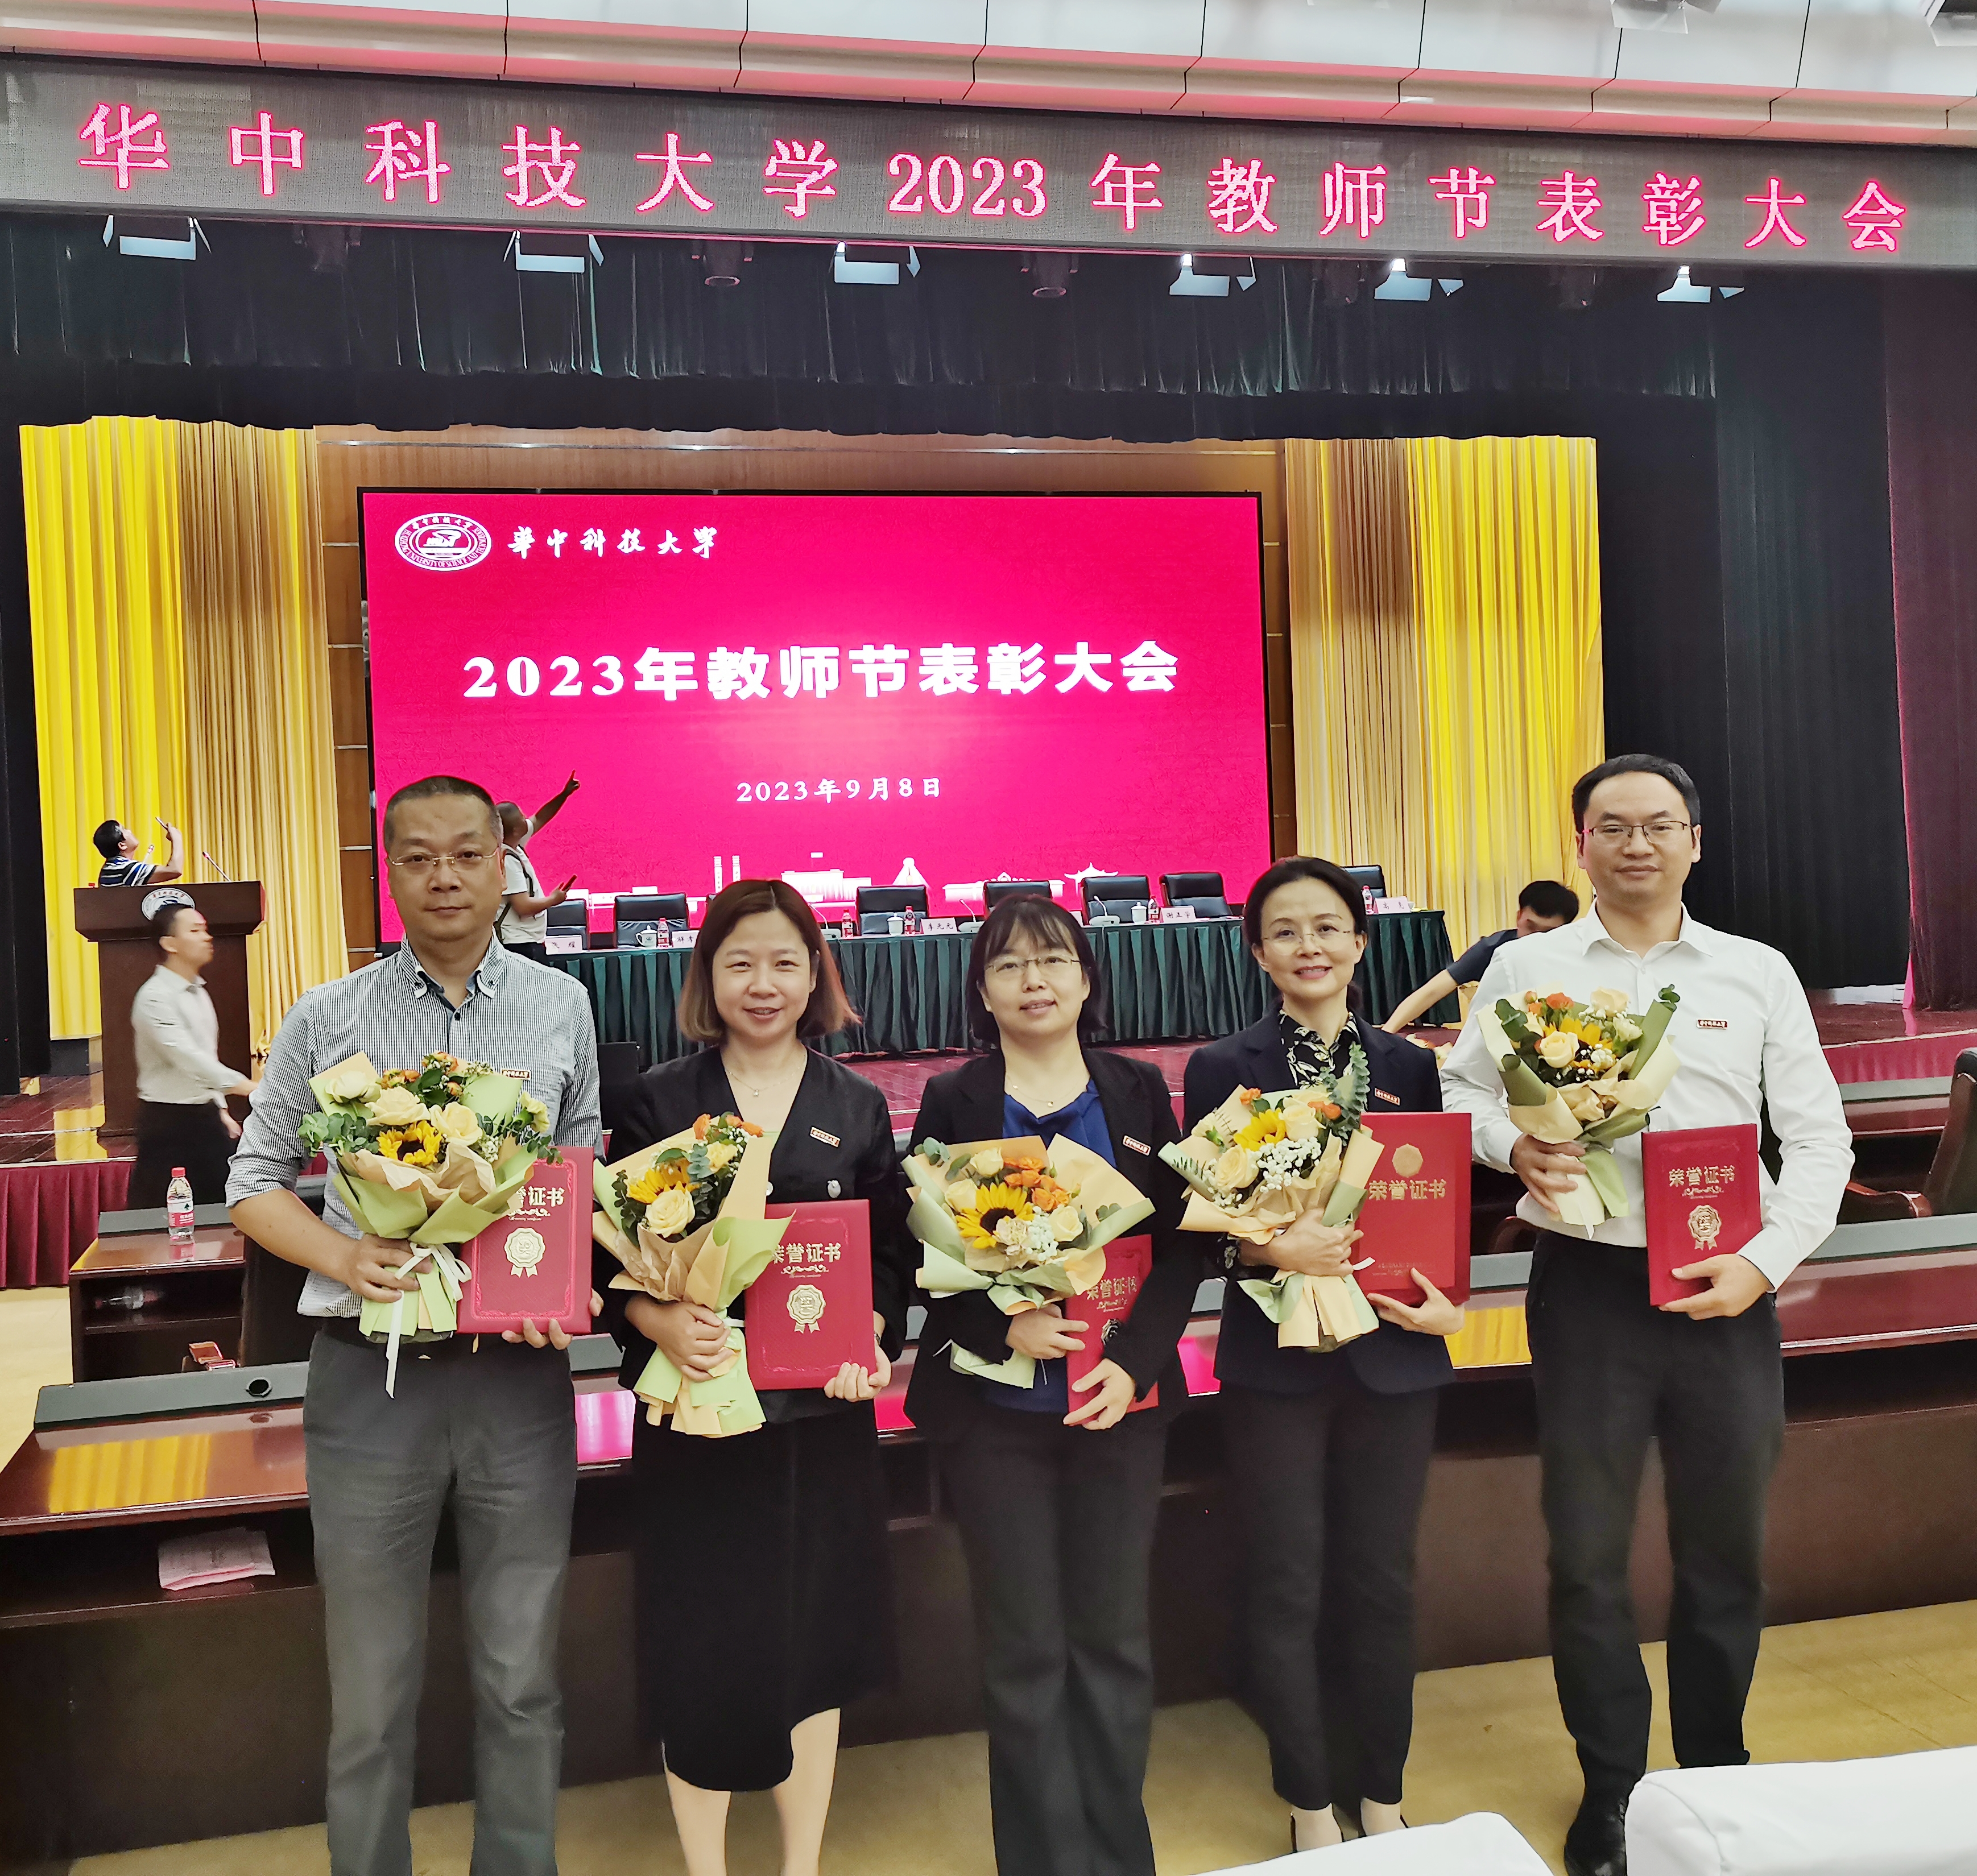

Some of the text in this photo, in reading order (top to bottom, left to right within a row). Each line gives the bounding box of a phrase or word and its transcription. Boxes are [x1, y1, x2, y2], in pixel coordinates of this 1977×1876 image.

[464, 640, 1178, 701] 2023年教师节表彰大会
[736, 777, 940, 804] 2023年9月8日
[1668, 1165, 1735, 1187] 荣誉证书
[1368, 1178, 1447, 1201] 荣誉证书
